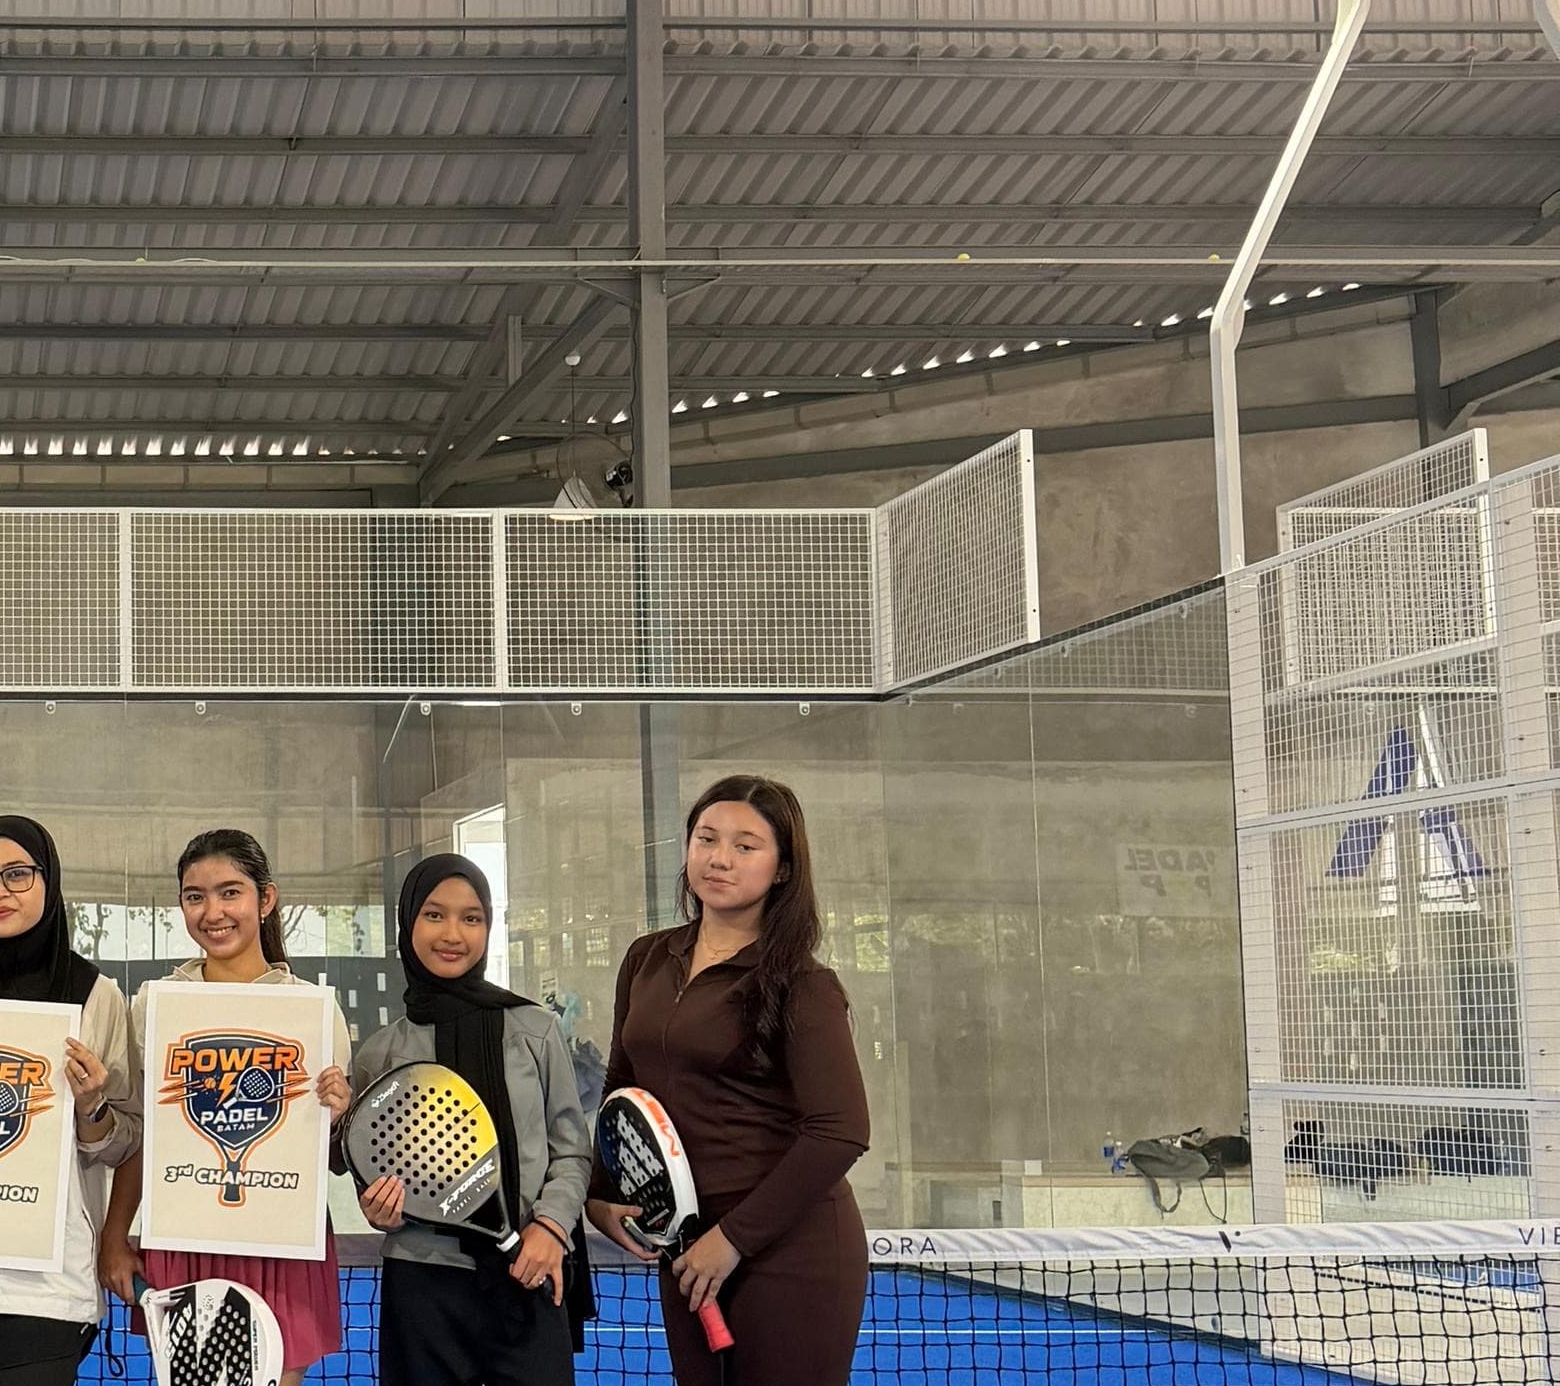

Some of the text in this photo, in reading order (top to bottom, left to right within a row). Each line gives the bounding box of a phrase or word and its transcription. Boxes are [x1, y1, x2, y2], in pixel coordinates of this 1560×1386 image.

[171, 1047, 299, 1074] POWER
[201, 1107, 268, 1125] PADEL
[216, 1124, 255, 1133] BATAM
[165, 1164, 299, 1189] 3rd CHAMPION
[873, 1236, 937, 1256] ORA
